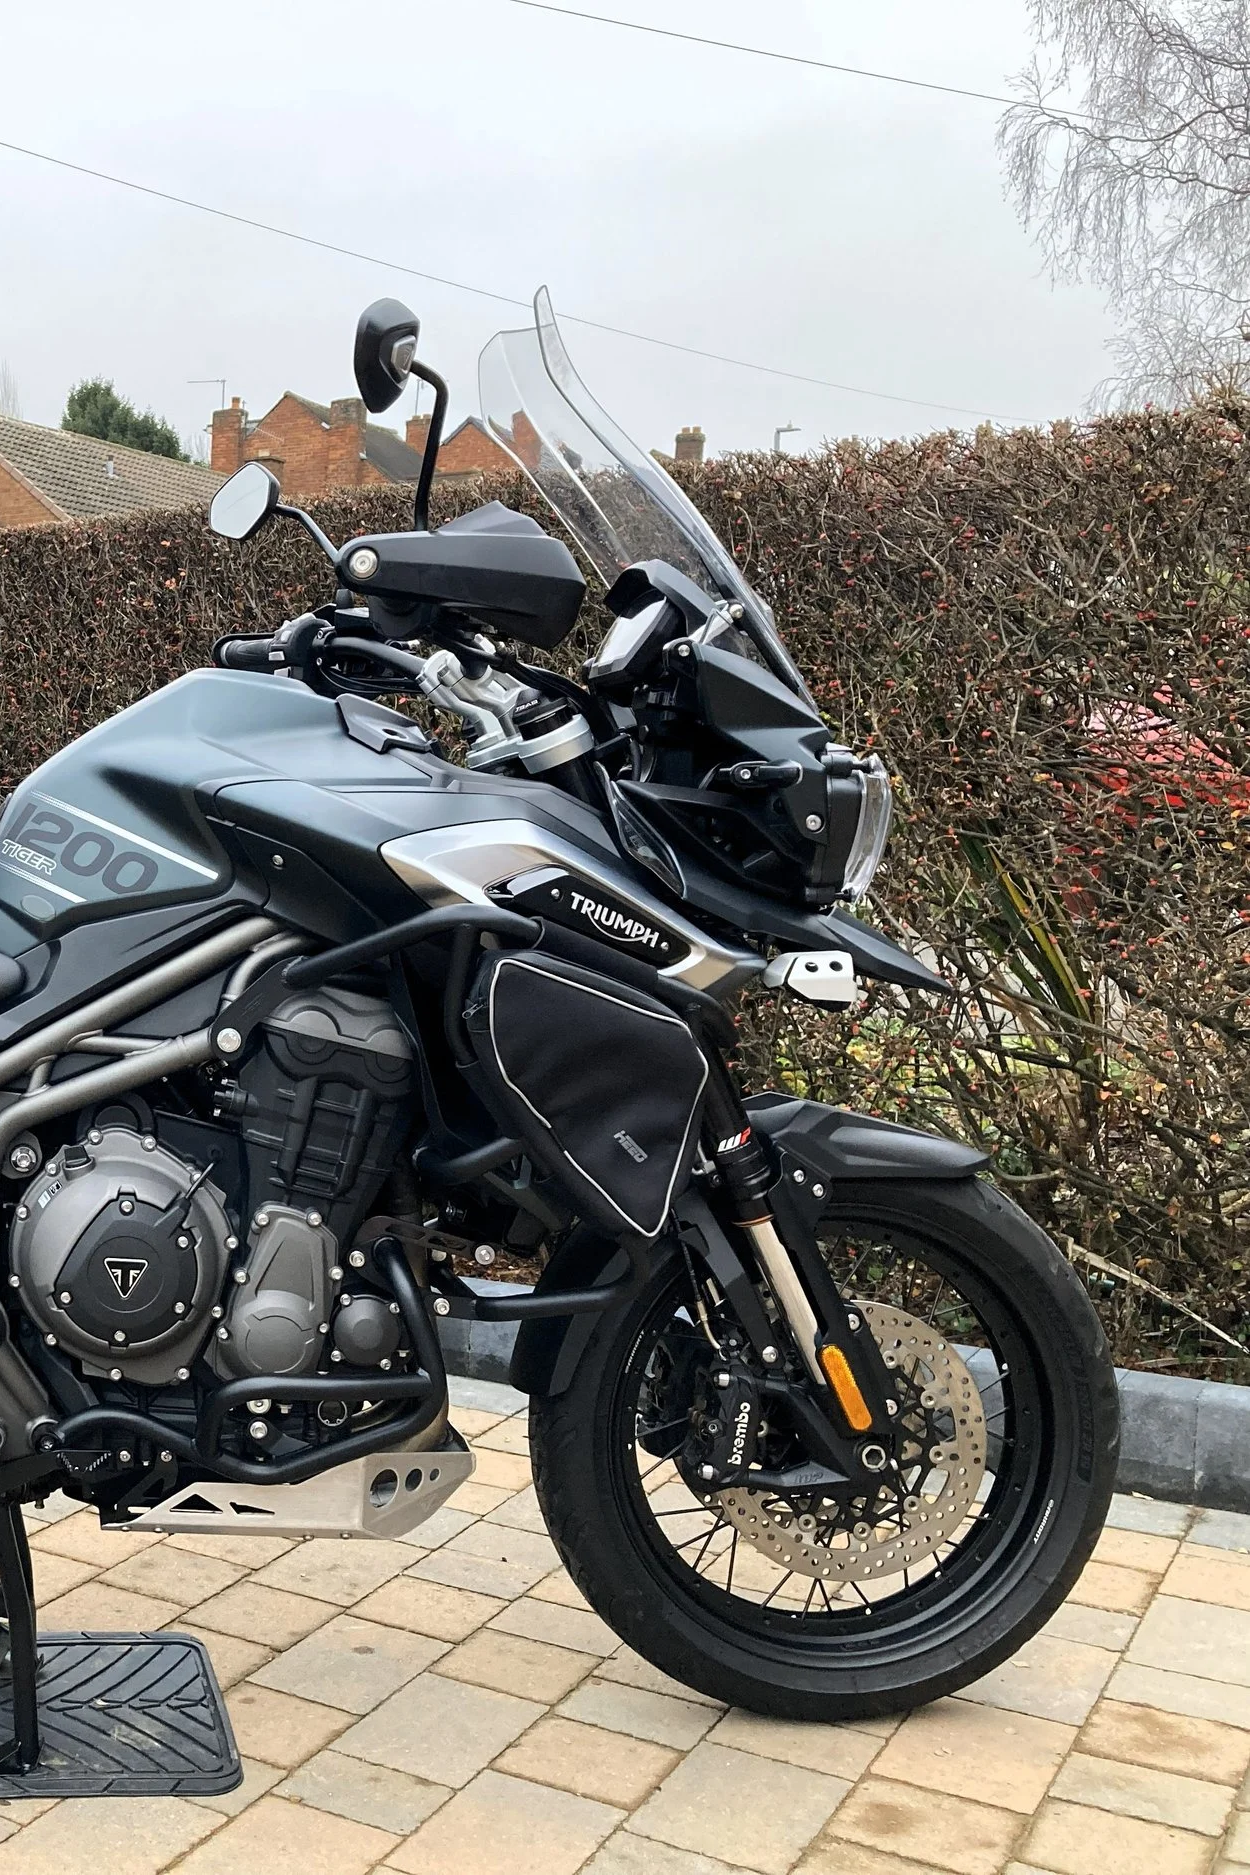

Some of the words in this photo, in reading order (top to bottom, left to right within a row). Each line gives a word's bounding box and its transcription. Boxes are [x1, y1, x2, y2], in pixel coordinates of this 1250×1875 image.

[1, 839, 57, 876] TIGER
[5, 803, 158, 895] 1200
[570, 891, 660, 948] TRIUMPH
[717, 1127, 751, 1152] WP
[727, 1402, 750, 1465] brembo
